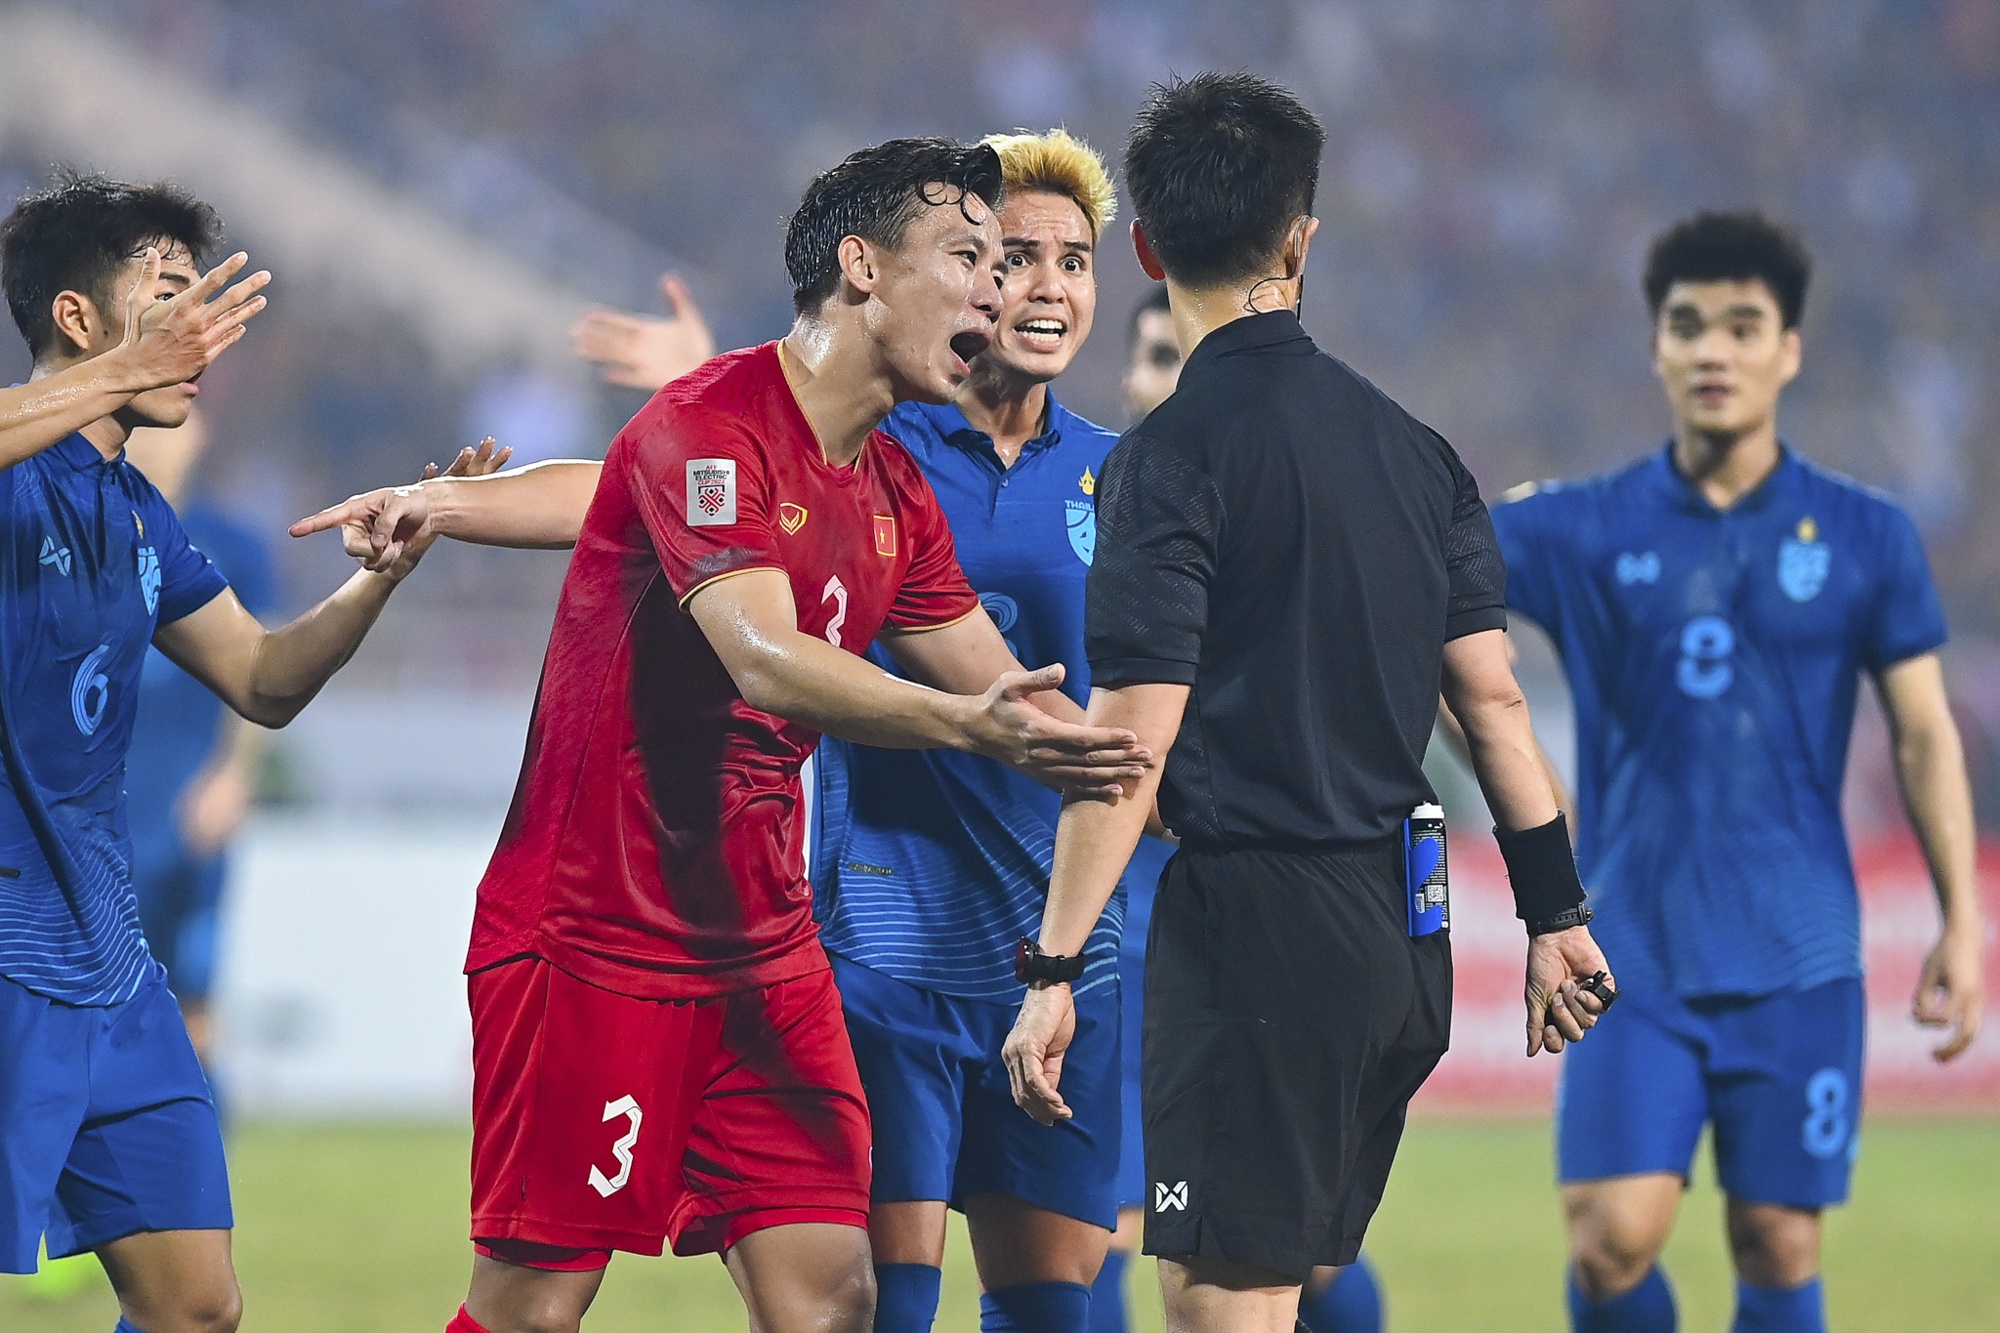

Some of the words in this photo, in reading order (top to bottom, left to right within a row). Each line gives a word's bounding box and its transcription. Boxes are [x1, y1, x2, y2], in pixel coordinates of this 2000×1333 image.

[71, 643, 109, 736] 6
[1677, 615, 1735, 699] 8
[587, 1093, 643, 1198] 3
[1803, 1068, 1848, 1157] 8
